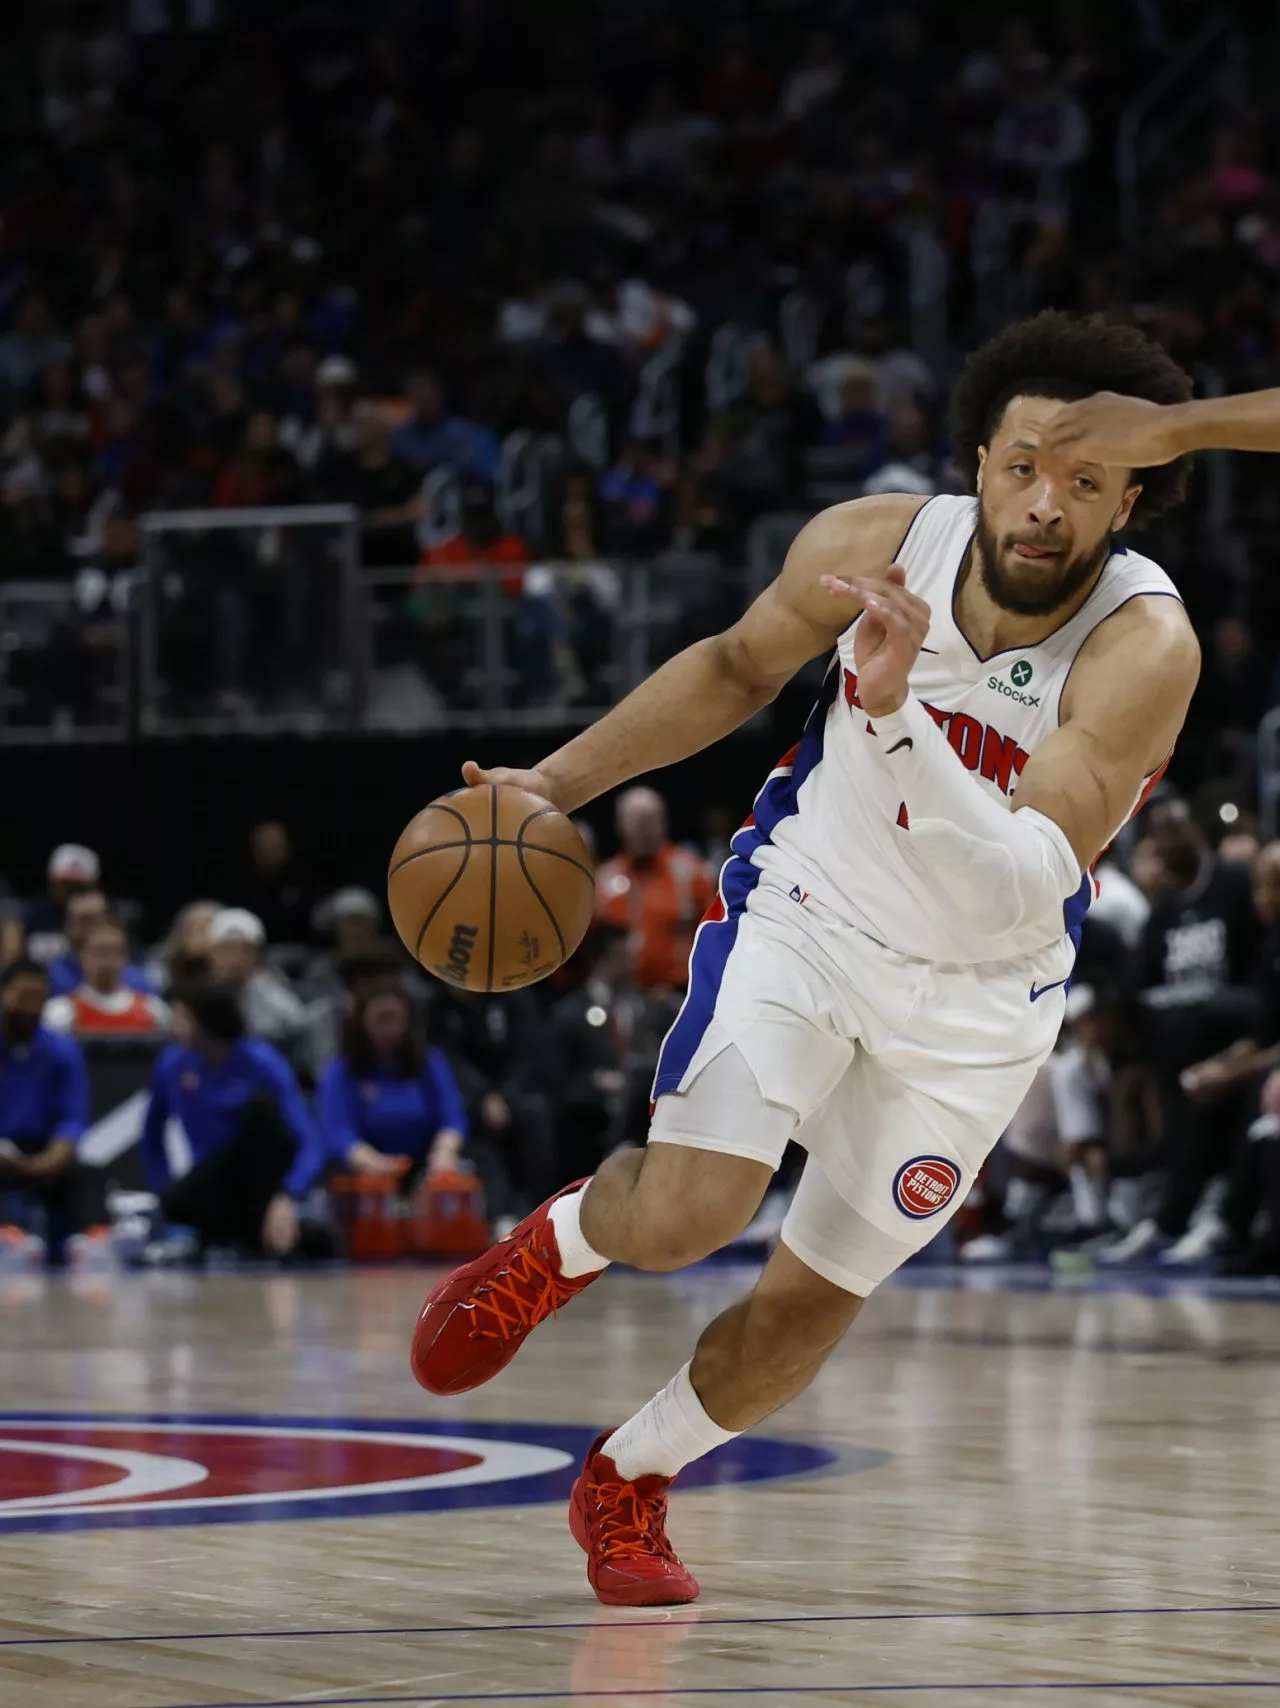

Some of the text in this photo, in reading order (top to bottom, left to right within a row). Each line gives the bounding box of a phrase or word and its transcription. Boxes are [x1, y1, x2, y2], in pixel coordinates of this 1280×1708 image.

[987, 676, 1040, 708] StockX
[907, 1178, 942, 1204] PISTONS
[914, 1169, 949, 1195] DETROIT
